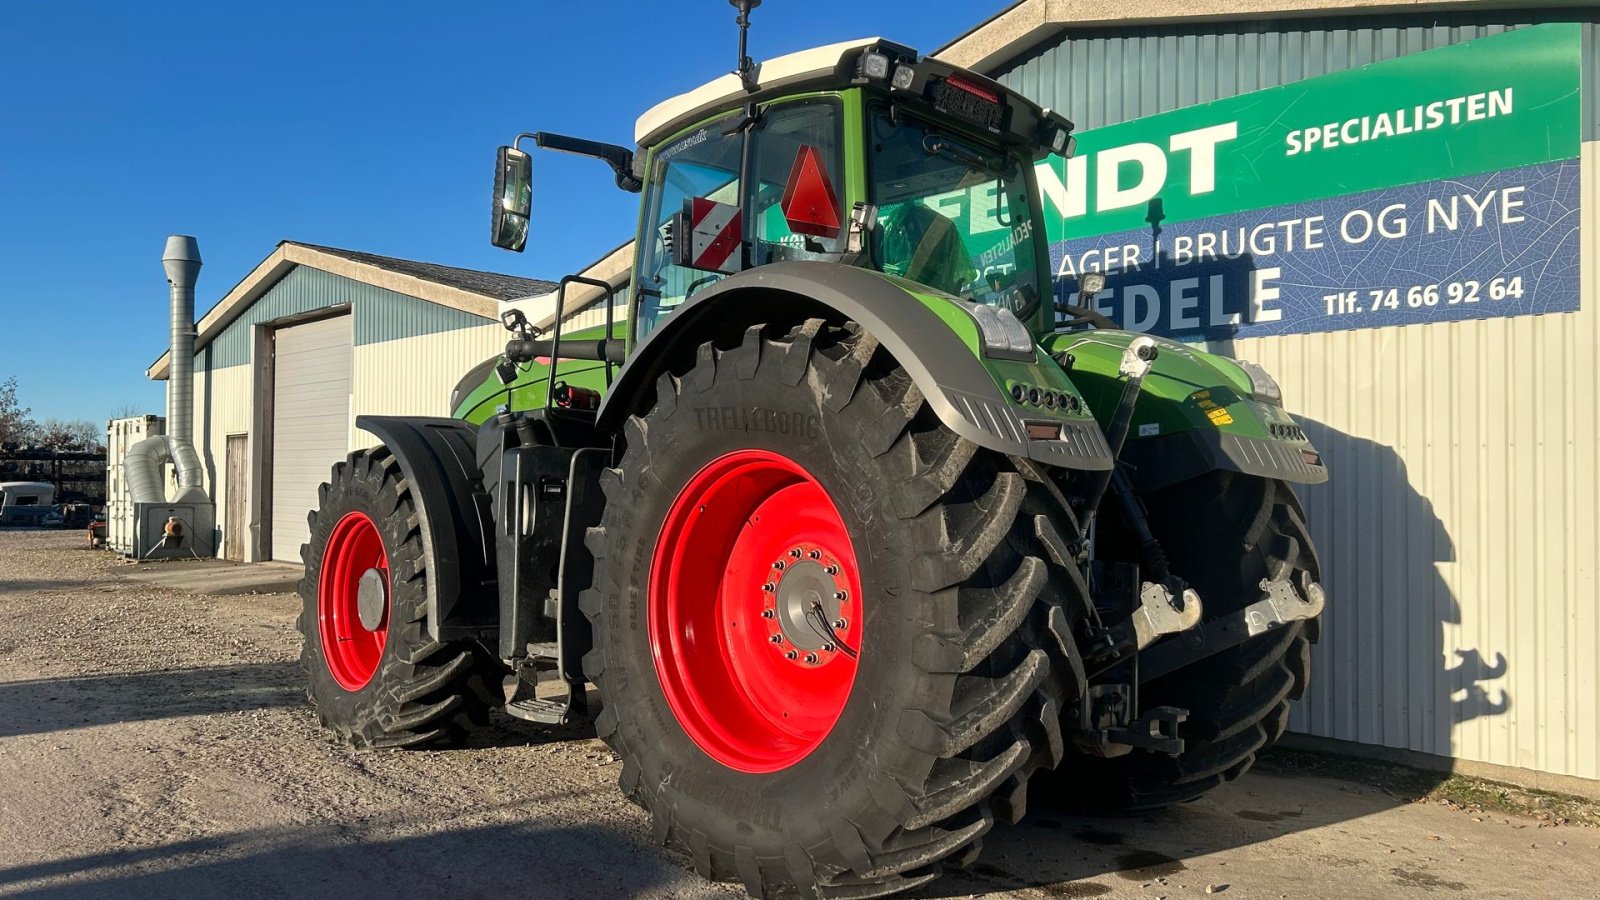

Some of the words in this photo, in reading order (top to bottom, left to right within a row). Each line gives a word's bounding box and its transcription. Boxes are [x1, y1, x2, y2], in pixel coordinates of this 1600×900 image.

[1285, 91, 1514, 157] SPECIALISTEN
[923, 121, 1238, 235] FENDT
[1051, 244, 1141, 284] AGER
[1174, 215, 1324, 267] BRUGTE
[1340, 203, 1408, 244] OG
[1427, 185, 1526, 235] NYE
[1322, 290, 1362, 316] Tlf.
[1369, 288, 1400, 312] 74
[1407, 284, 1440, 308] 66
[1447, 280, 1481, 305] 92
[1488, 276, 1524, 301] 64
[693, 406, 819, 440] TRELLEBORG
